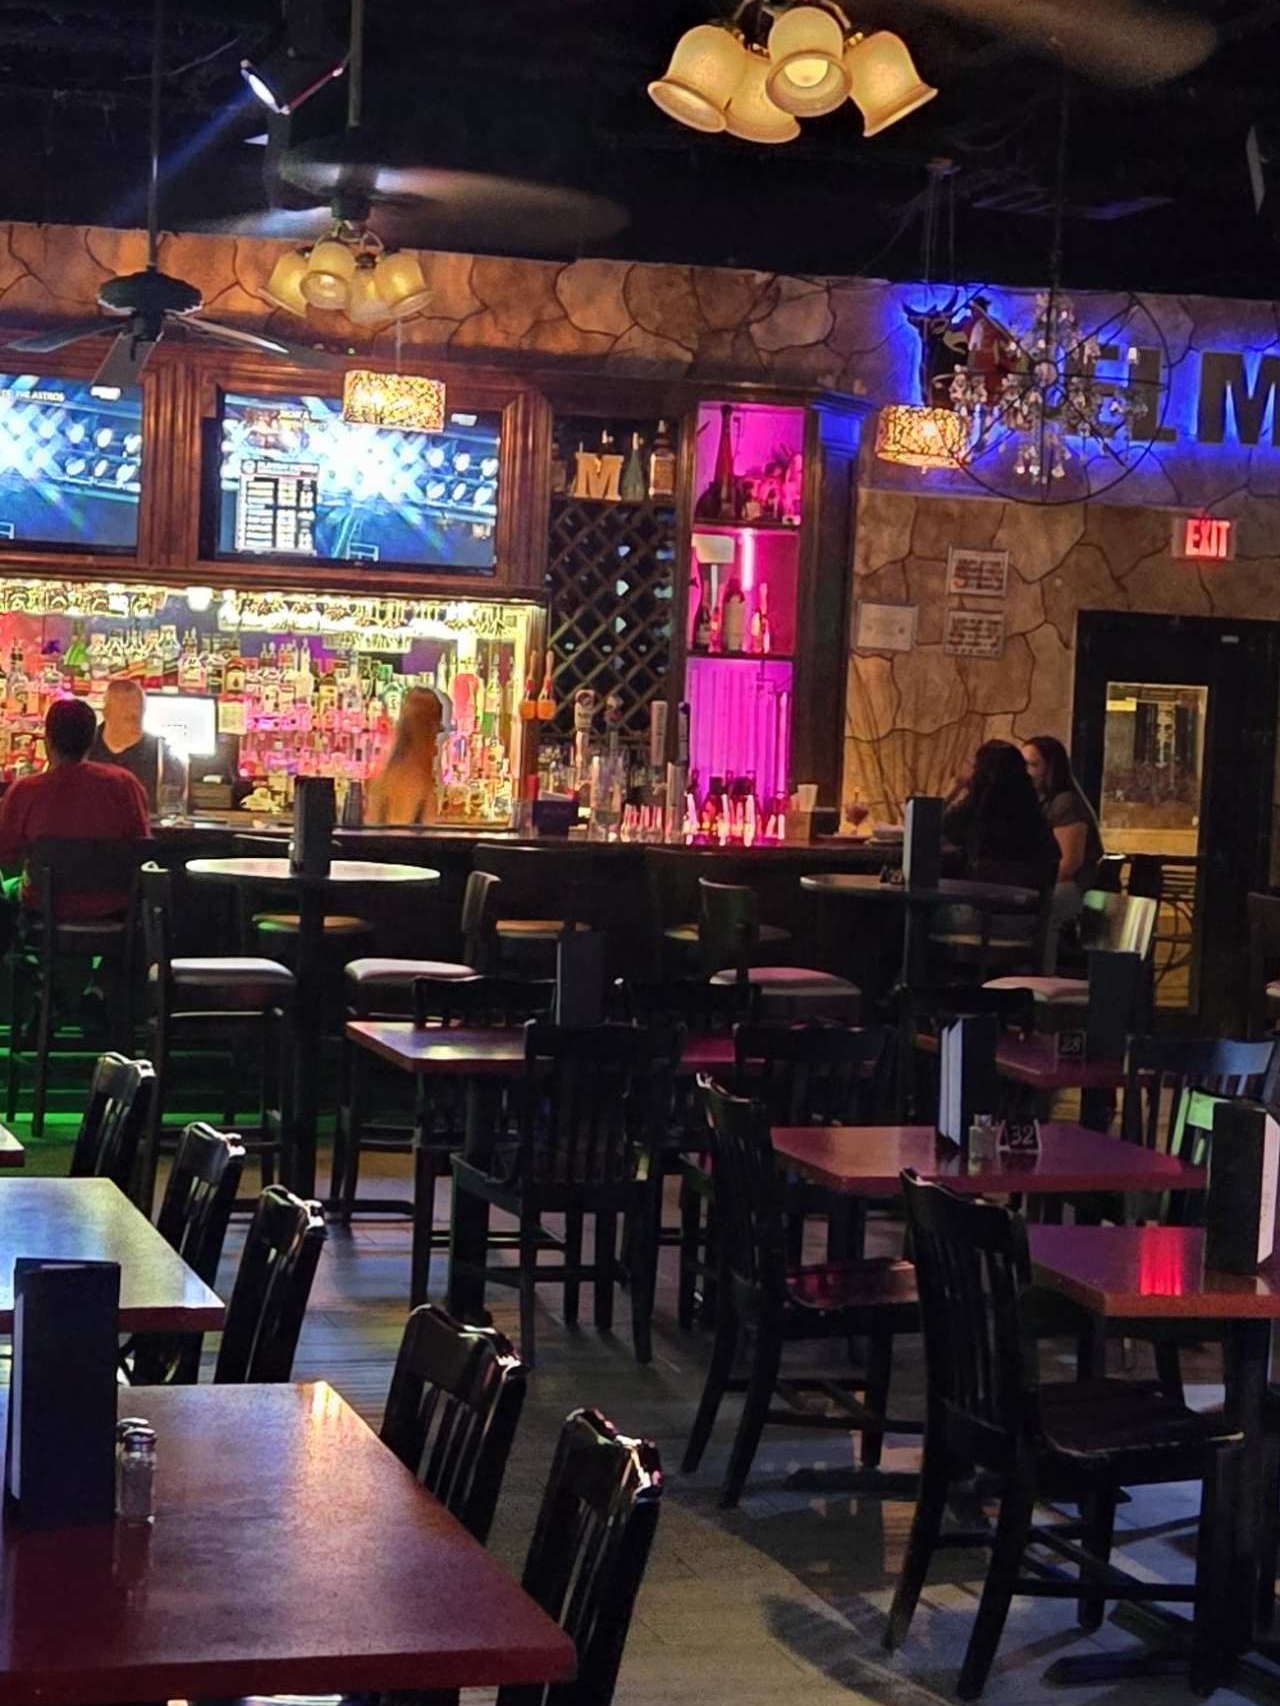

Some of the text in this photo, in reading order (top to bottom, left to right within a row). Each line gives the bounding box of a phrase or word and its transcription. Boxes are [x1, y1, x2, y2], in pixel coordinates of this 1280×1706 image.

[31, 390, 65, 402] ASTROS
[573, 452, 624, 501] M
[1185, 519, 1231, 558] EXIT
[1010, 1125, 1035, 1146] 32
